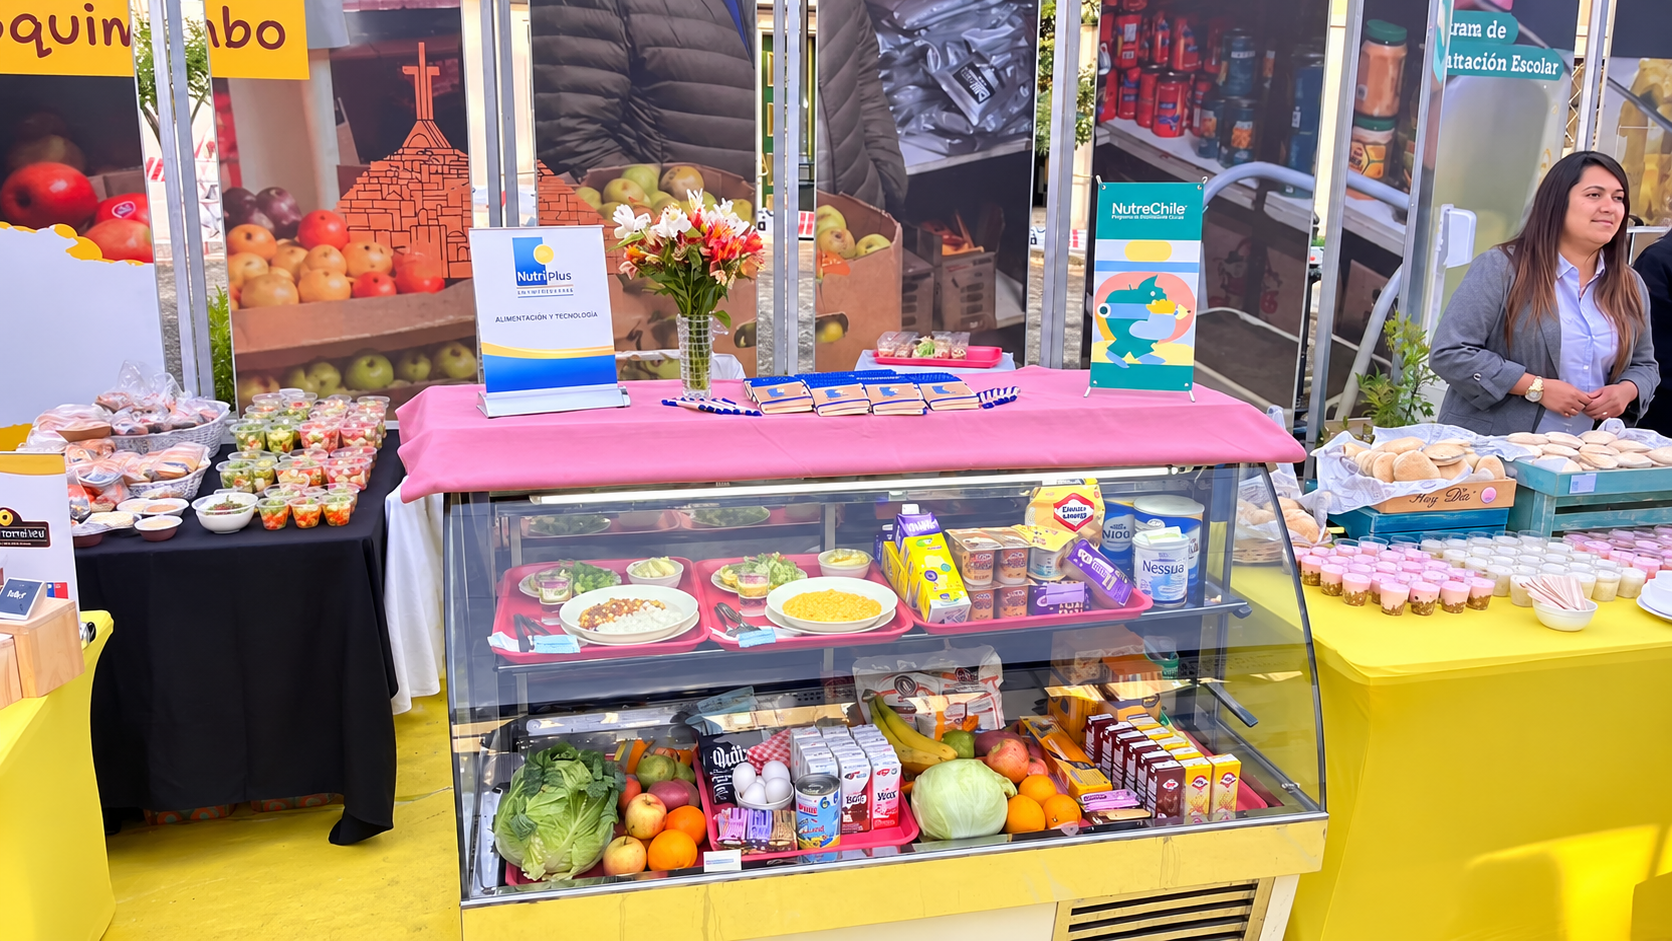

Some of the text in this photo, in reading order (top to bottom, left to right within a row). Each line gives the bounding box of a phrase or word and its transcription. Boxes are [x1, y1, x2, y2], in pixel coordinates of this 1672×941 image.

[1487, 20, 1507, 39] de
[1510, 54, 1559, 75] Escolar
[1112, 202, 1186, 215] NutreChile
